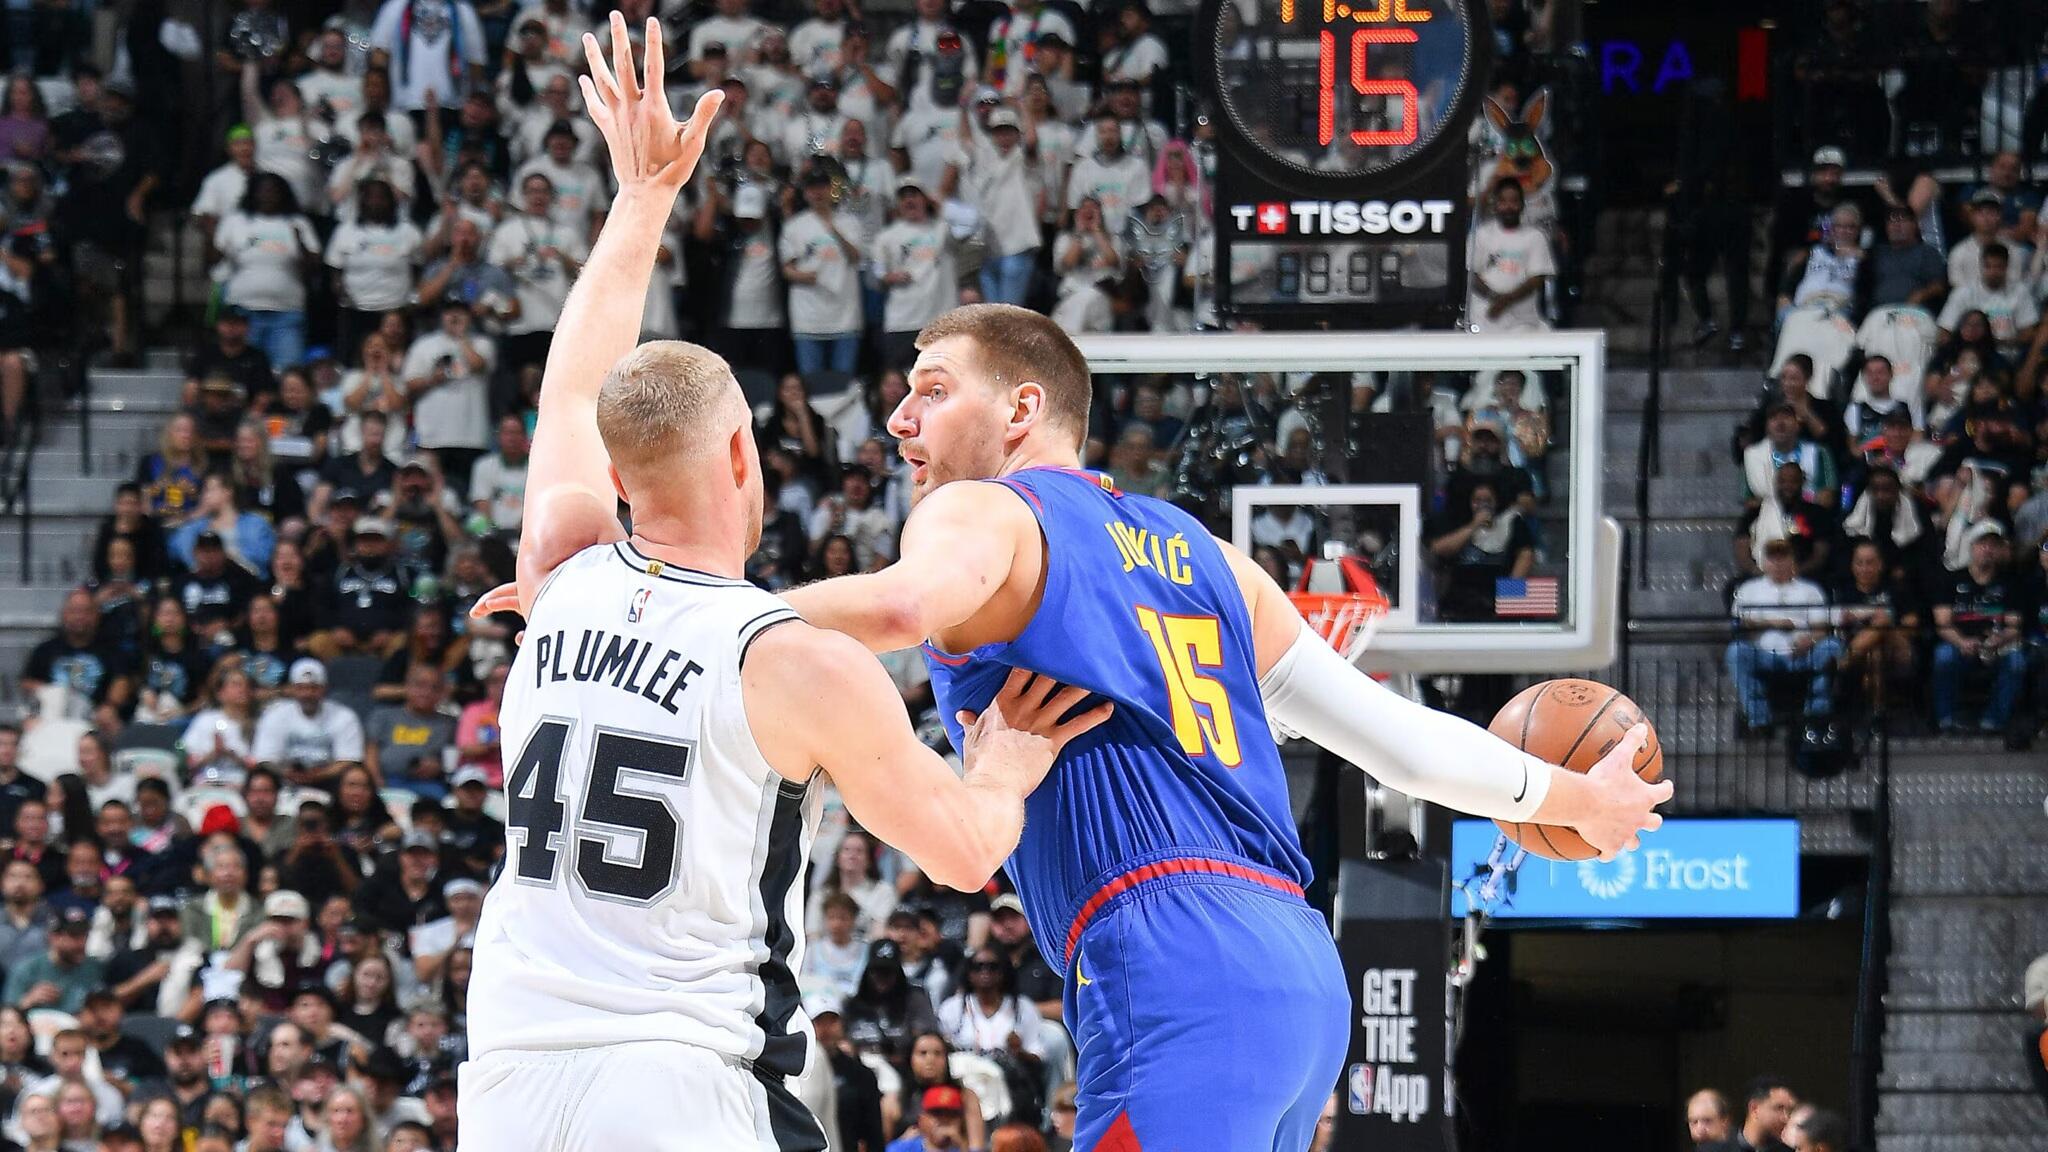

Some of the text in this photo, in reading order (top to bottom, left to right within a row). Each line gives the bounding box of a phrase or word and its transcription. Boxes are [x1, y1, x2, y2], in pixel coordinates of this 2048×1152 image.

[1319, 29, 1419, 146] 15
[1290, 201, 1454, 234] TISSOT
[536, 630, 704, 715] PLUMLEE
[1135, 604, 1243, 769] 15
[504, 714, 697, 909] 45
[1643, 850, 1751, 891] Frost
[1362, 968, 1417, 1015] GET
[1361, 1015, 1418, 1063] THE
[1372, 1064, 1429, 1123] App
